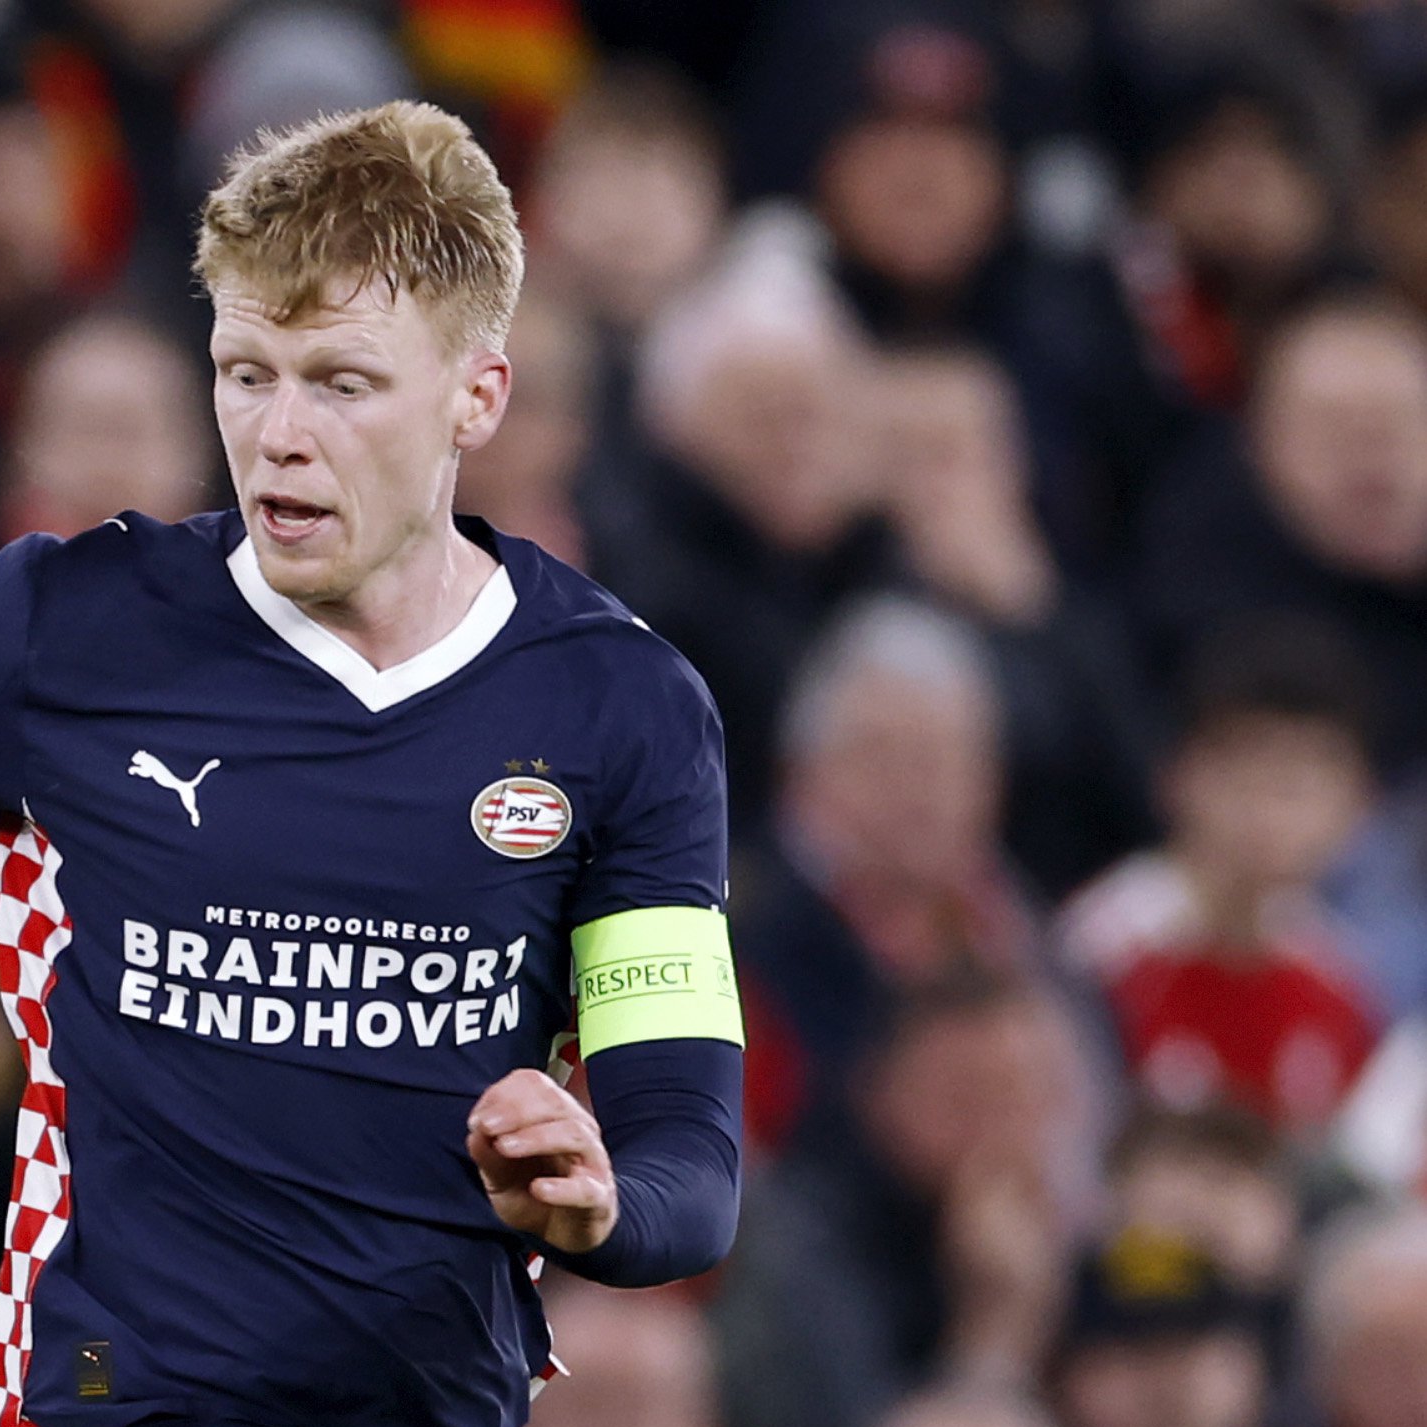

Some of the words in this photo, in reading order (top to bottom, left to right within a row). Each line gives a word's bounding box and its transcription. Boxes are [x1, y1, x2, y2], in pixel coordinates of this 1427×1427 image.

[506, 805, 542, 822] PSV
[205, 905, 471, 942] METROPOOLREGIO
[123, 918, 527, 994] BRAINPORT
[585, 961, 692, 1001] RESPECT
[119, 968, 520, 1048] EINDHOVEN
